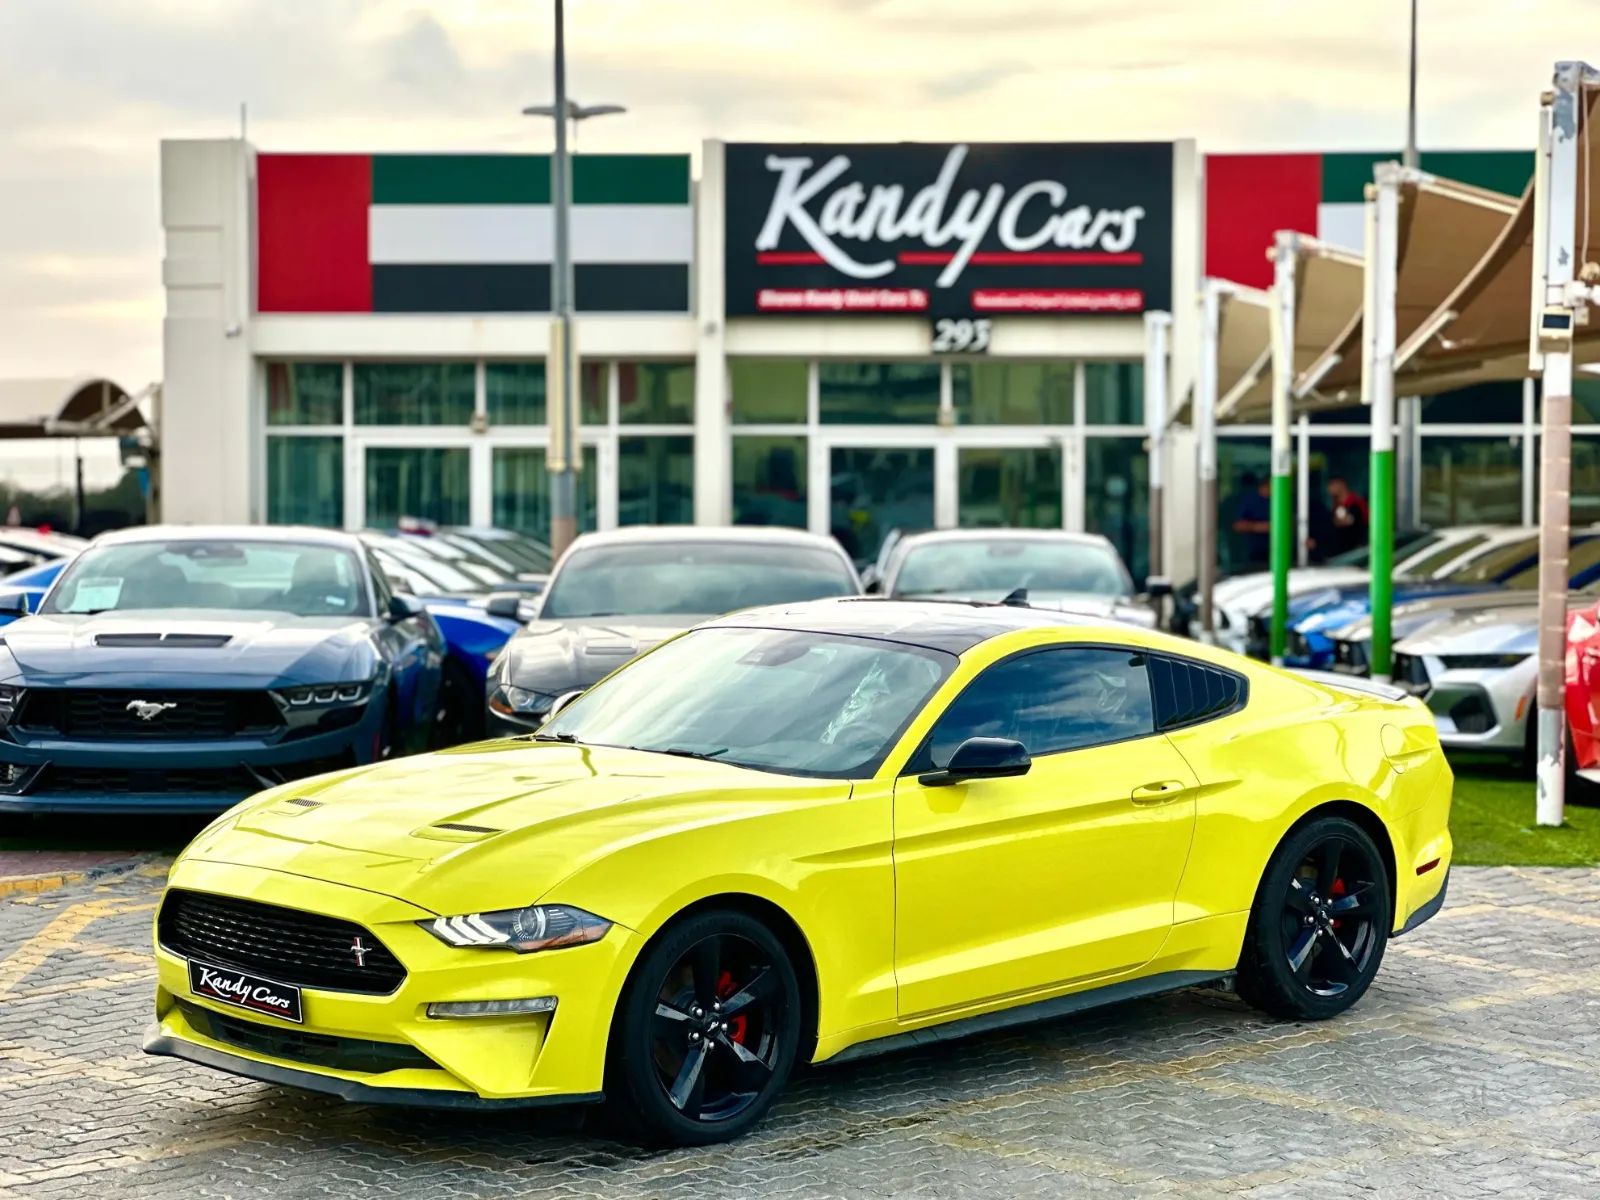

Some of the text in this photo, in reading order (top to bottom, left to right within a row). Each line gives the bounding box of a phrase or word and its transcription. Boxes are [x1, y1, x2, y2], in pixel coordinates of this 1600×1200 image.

[755, 144, 1145, 288] Kandy Cars
[199, 966, 291, 1009] Kandy Cars
